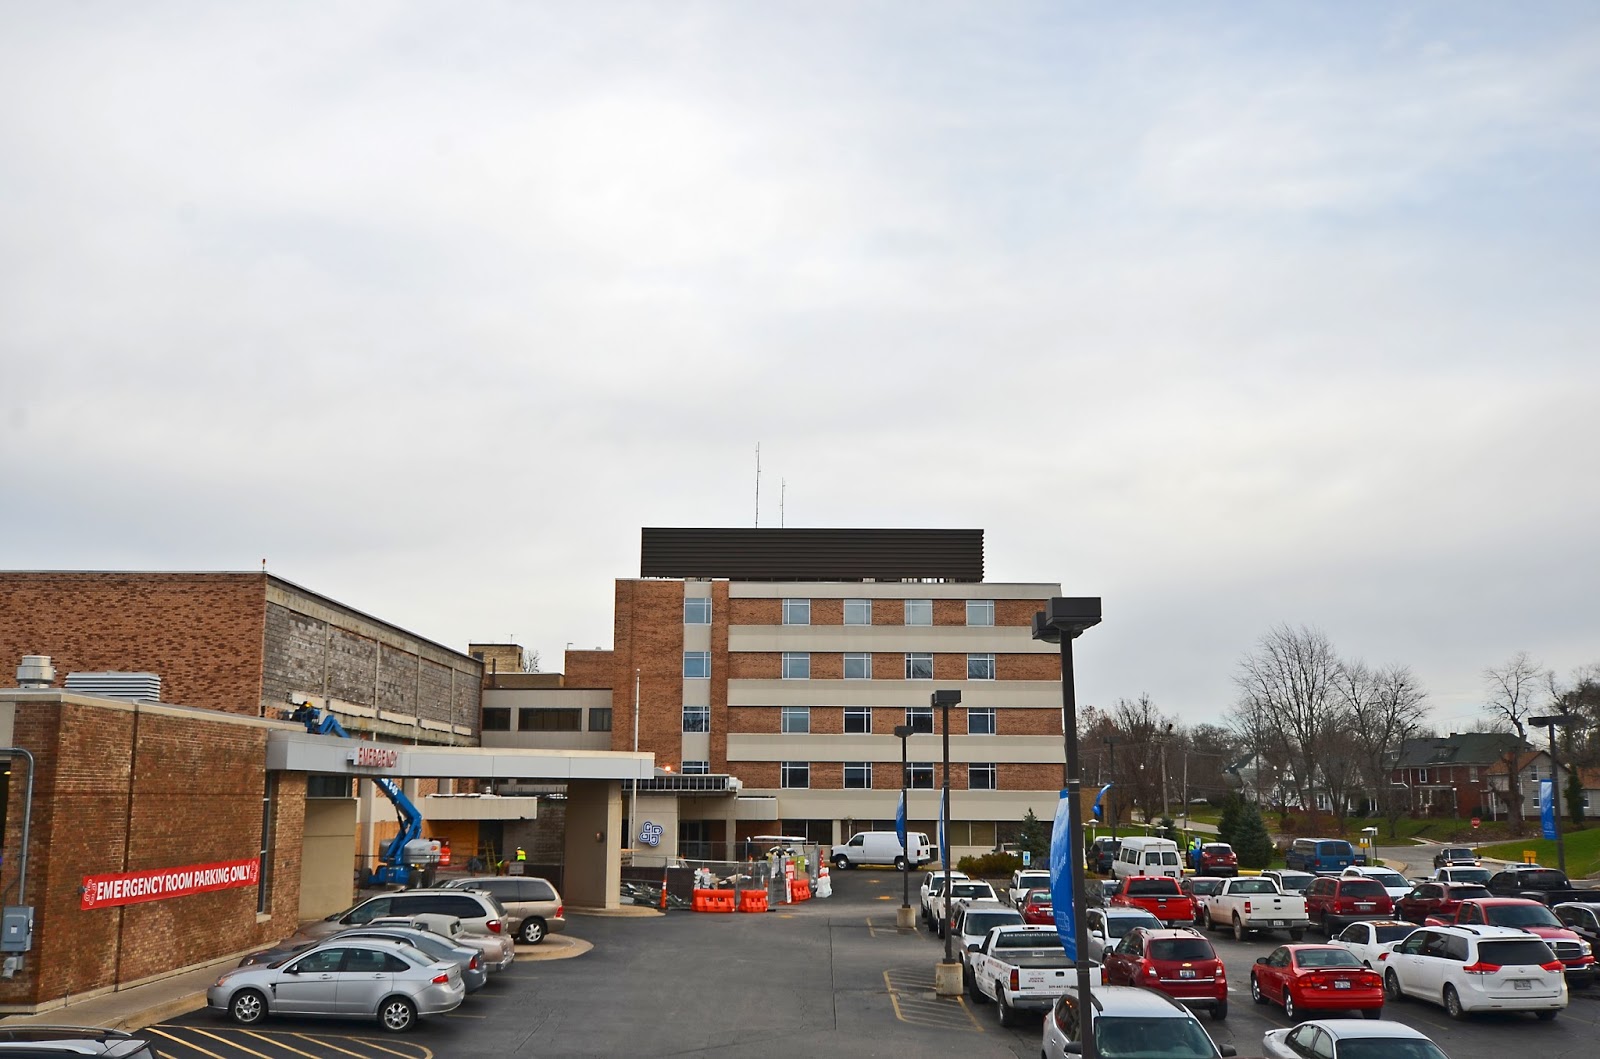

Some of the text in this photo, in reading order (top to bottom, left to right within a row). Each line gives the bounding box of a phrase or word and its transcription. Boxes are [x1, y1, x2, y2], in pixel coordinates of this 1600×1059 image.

[358, 747, 398, 768] EMERGENCY
[96, 864, 251, 901] EMERGENCY ROOM PARKING ONLY
